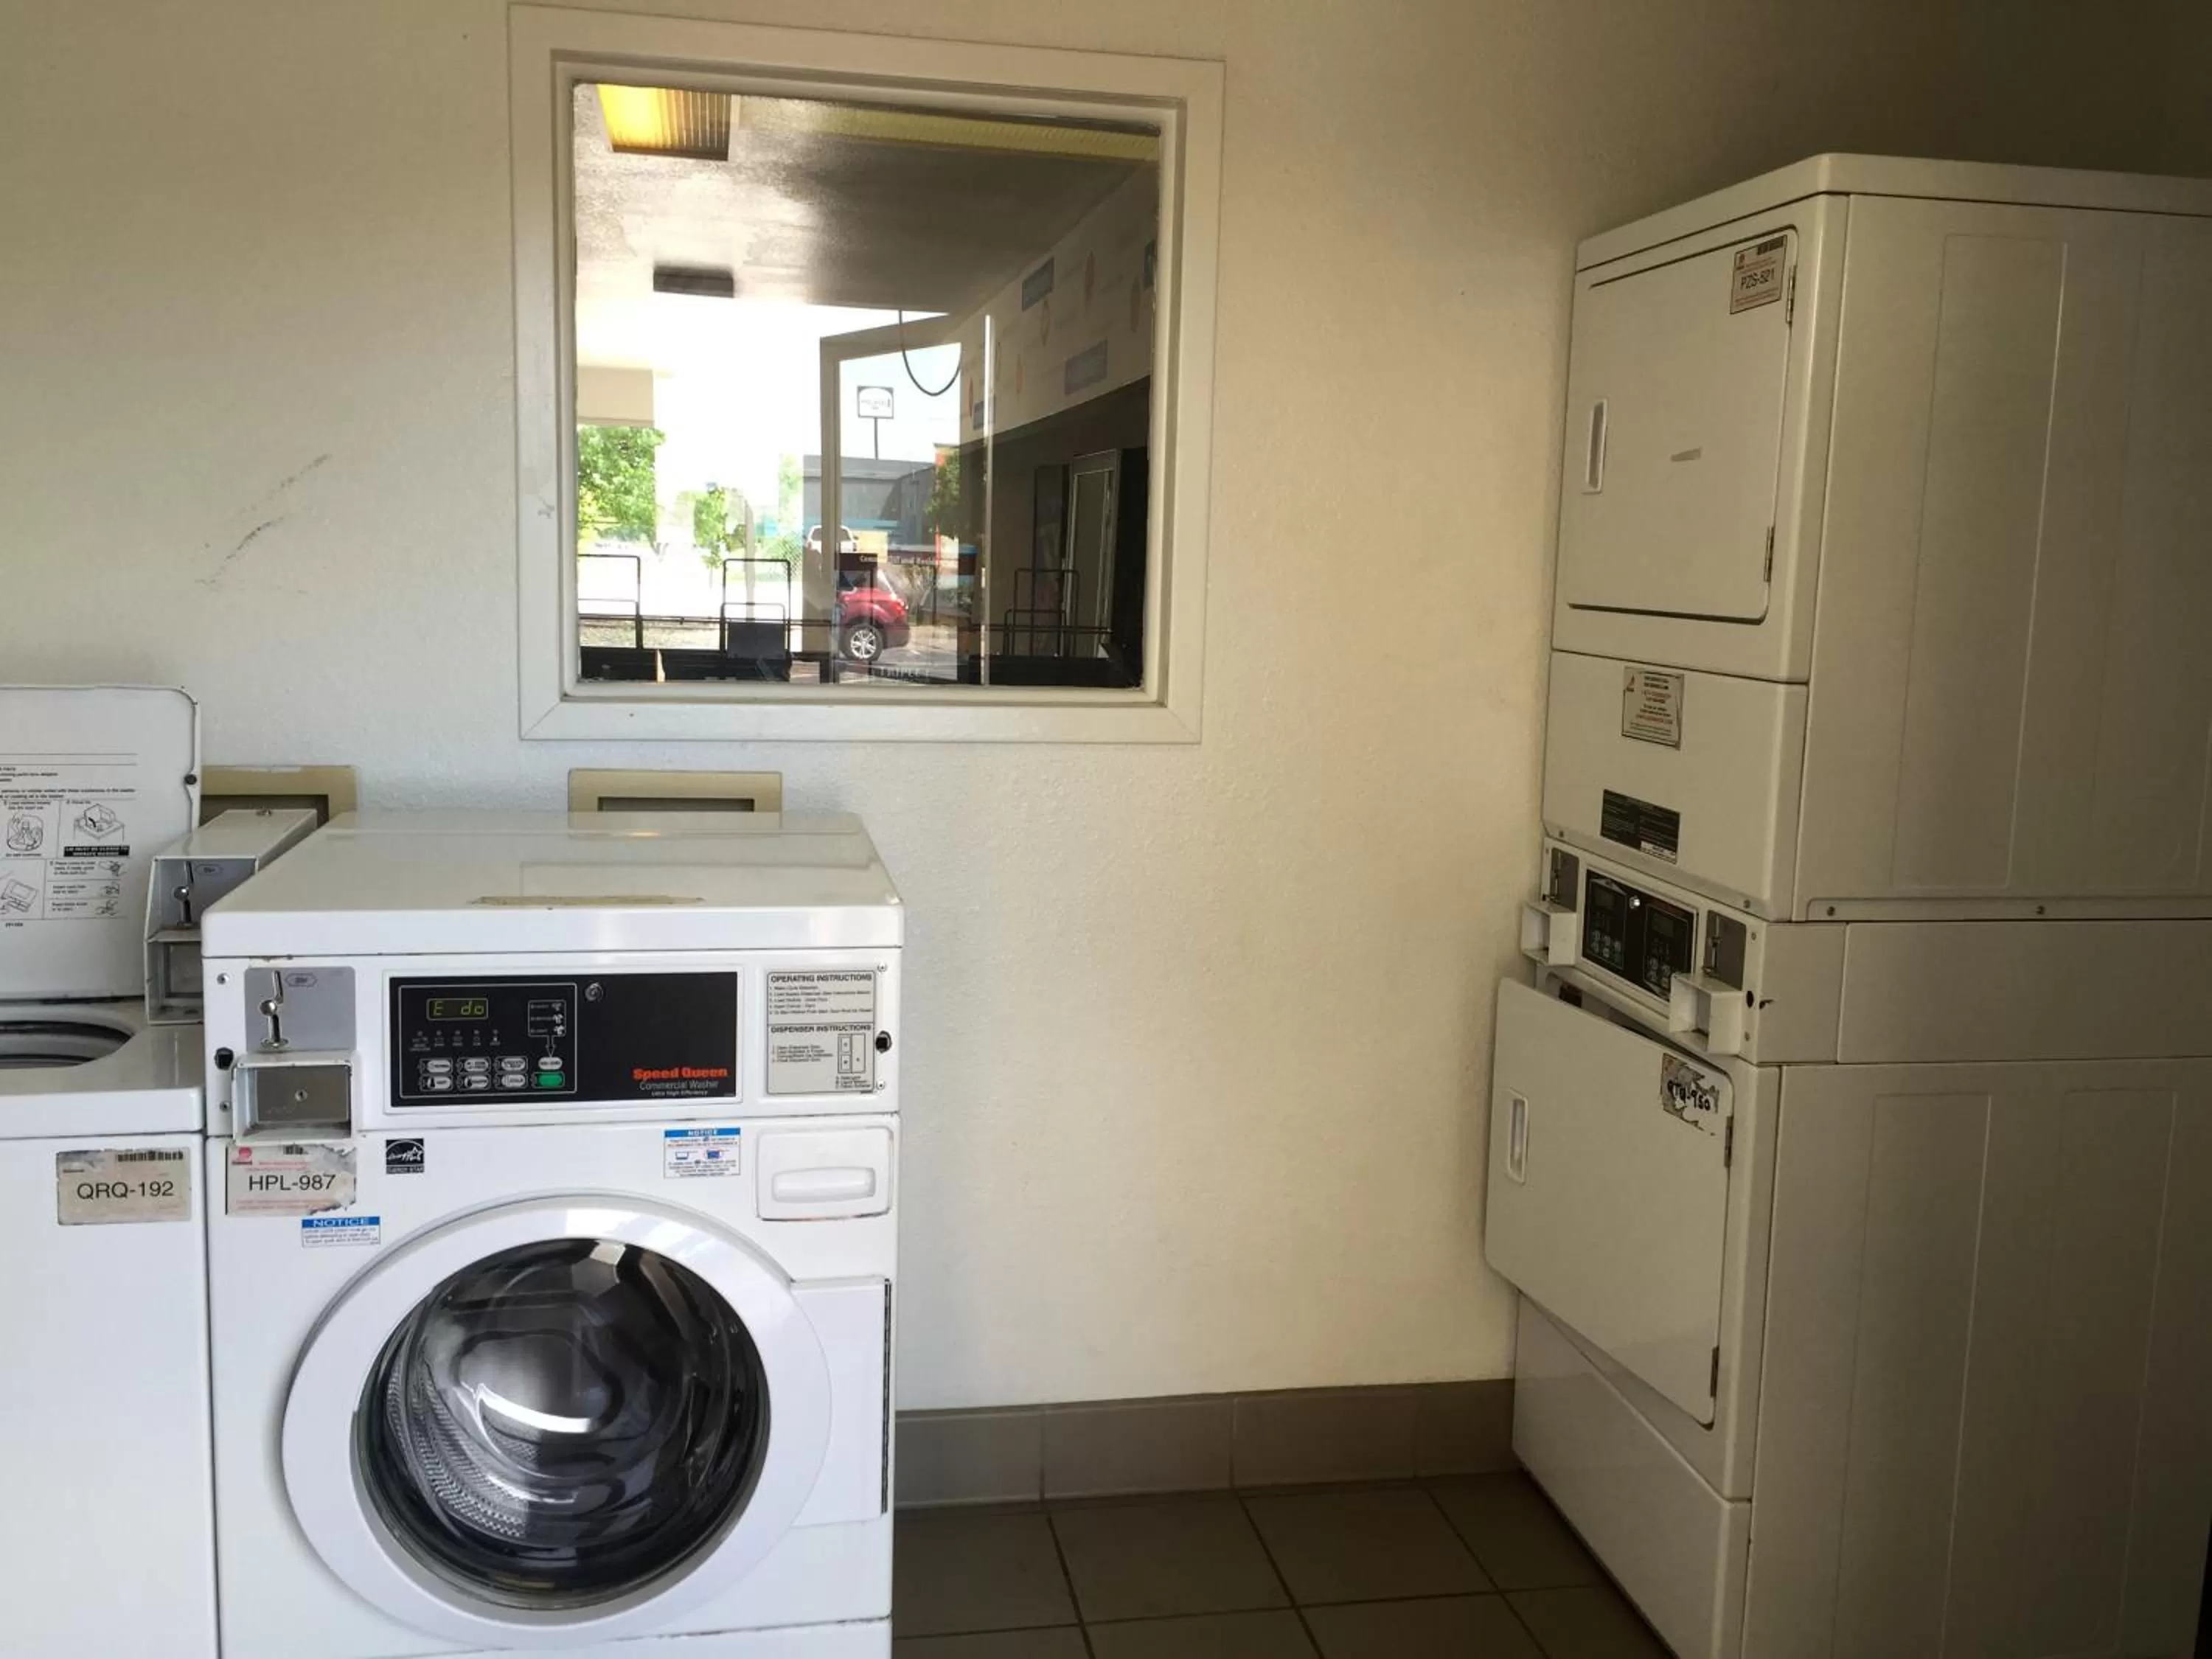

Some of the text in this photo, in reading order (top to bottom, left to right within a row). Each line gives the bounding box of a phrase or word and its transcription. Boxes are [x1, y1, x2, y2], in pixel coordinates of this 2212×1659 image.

[771, 973, 872, 983] OPERATING INSTRUCTIONS
[816, 1024, 872, 1032] INSTRUCTIONS
[633, 1068, 728, 1081] Speed Queen
[639, 1079, 720, 1091] Commercial Washer
[248, 1173, 337, 1192] HPL-987
[76, 1180, 175, 1200] QRQ-192
[313, 1219, 366, 1228] NOTICE
